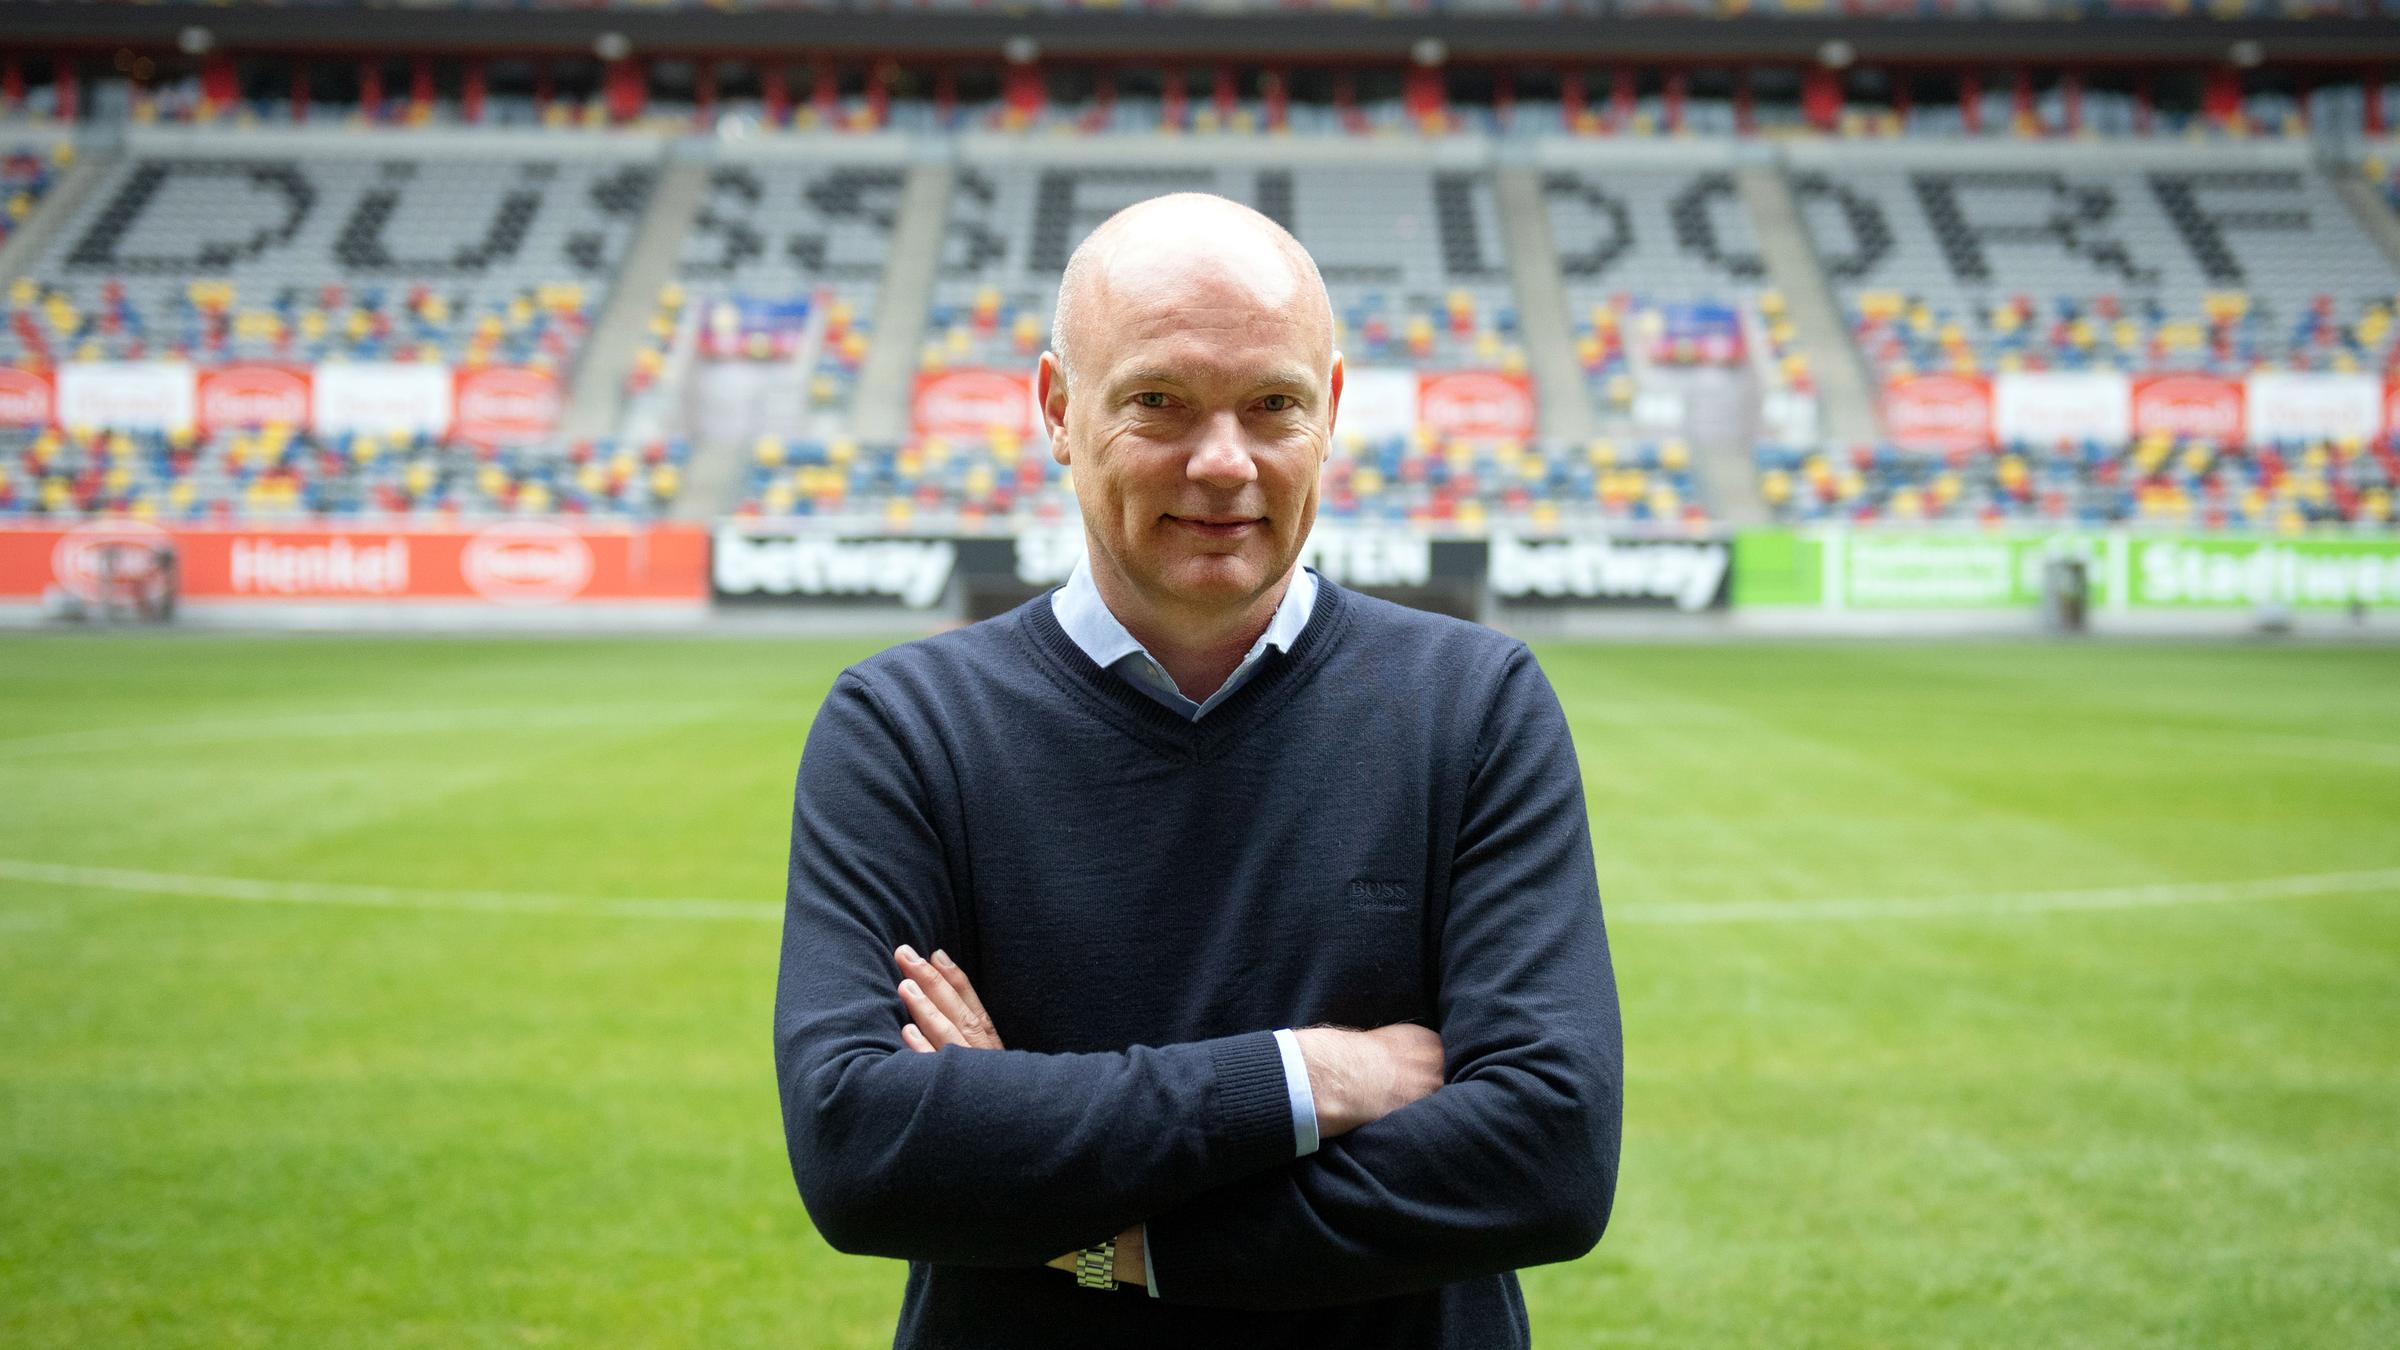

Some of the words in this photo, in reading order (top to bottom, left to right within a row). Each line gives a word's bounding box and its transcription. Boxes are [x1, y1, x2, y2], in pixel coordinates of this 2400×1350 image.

[230, 537, 410, 593] Henkel
[714, 527, 957, 608] betway
[1489, 528, 1730, 611] betway
[1351, 880, 1407, 898] BOSS
